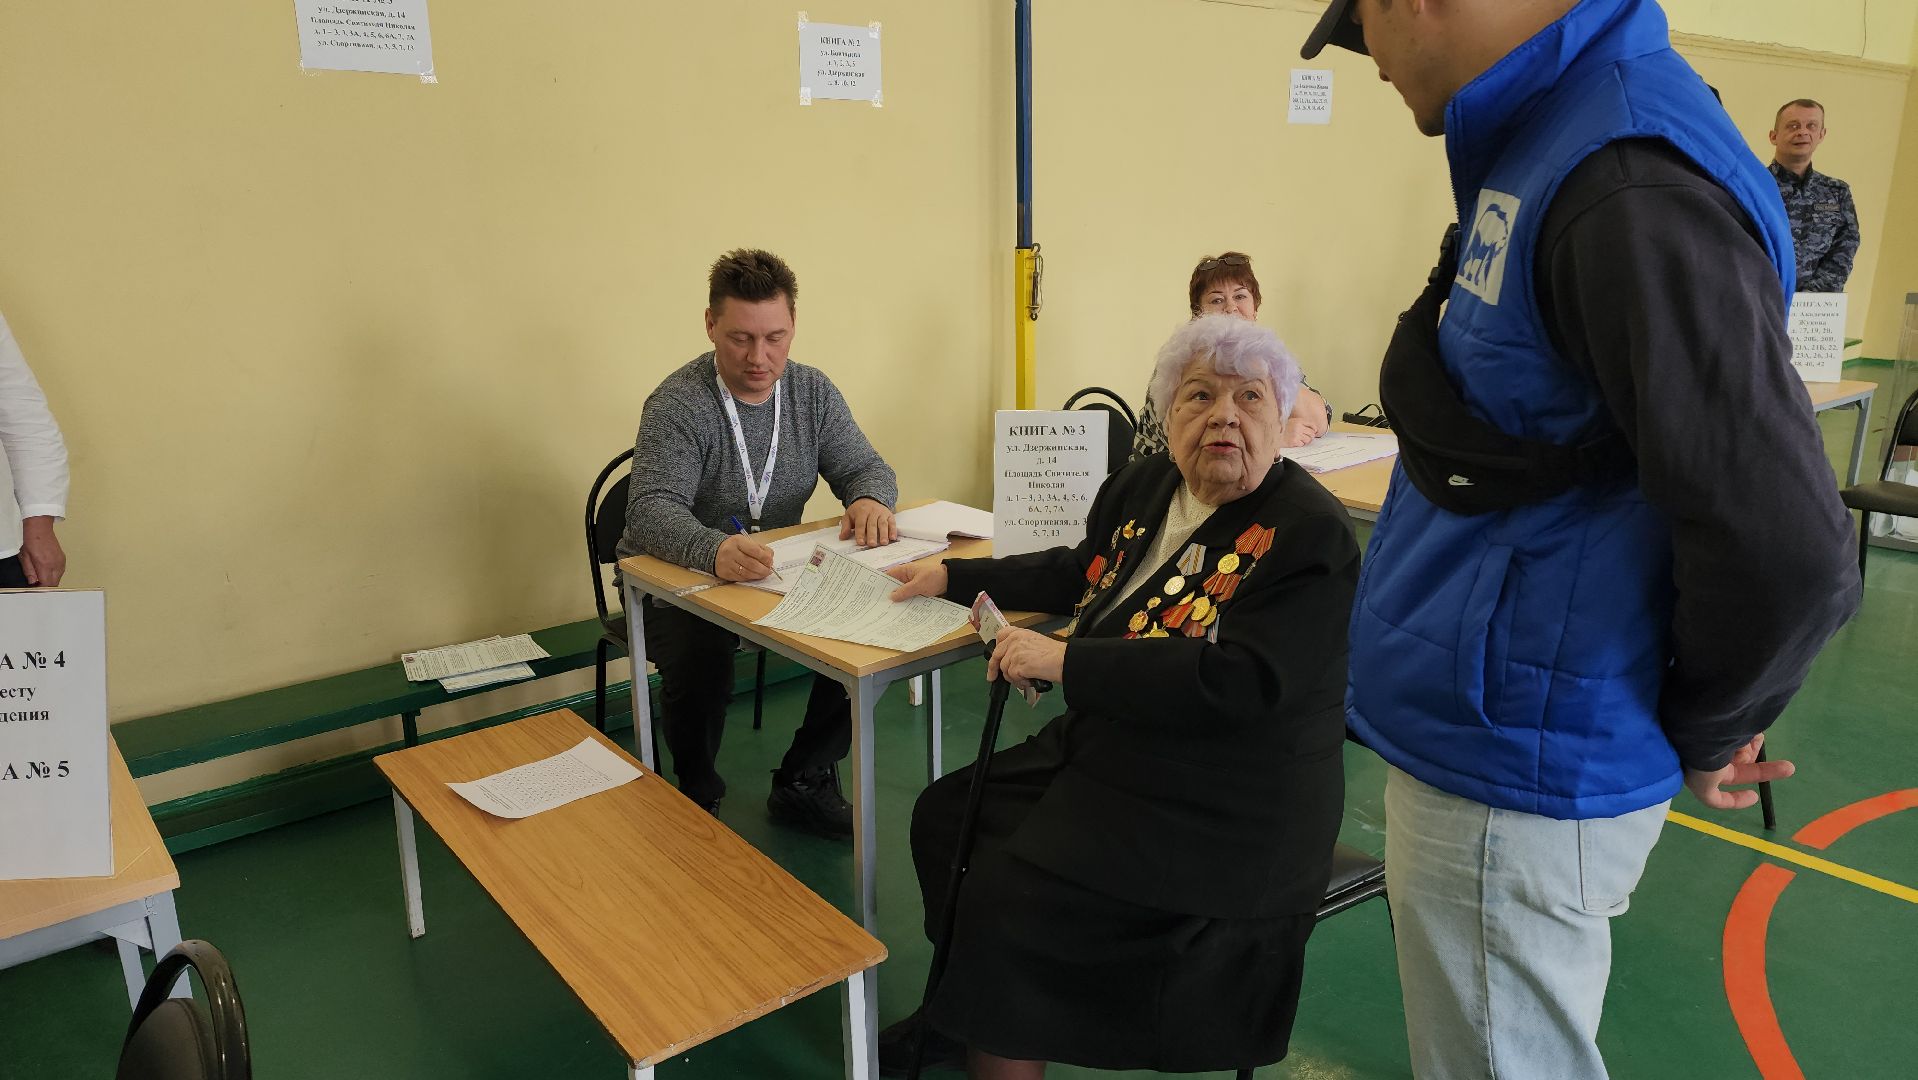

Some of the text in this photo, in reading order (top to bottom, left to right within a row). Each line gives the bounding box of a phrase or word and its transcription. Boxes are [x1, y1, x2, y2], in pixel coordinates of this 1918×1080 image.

[820, 36, 846, 45] КНИГА
[1009, 425, 1086, 436] КНИГА № 3
[1006, 444, 1088, 453] ул. Дзержинская,
[1004, 470, 1042, 478] Площадь
[1038, 494, 1044, 502] 3,
[1047, 494, 1060, 502] 3А,
[1072, 494, 1078, 502] 5,
[1081, 493, 1087, 502] 6,
[1044, 505, 1051, 514] 7,
[22, 651, 46, 669] №
[54, 650, 66, 667] 4
[26, 761, 50, 779] №
[58, 760, 69, 778] 5
